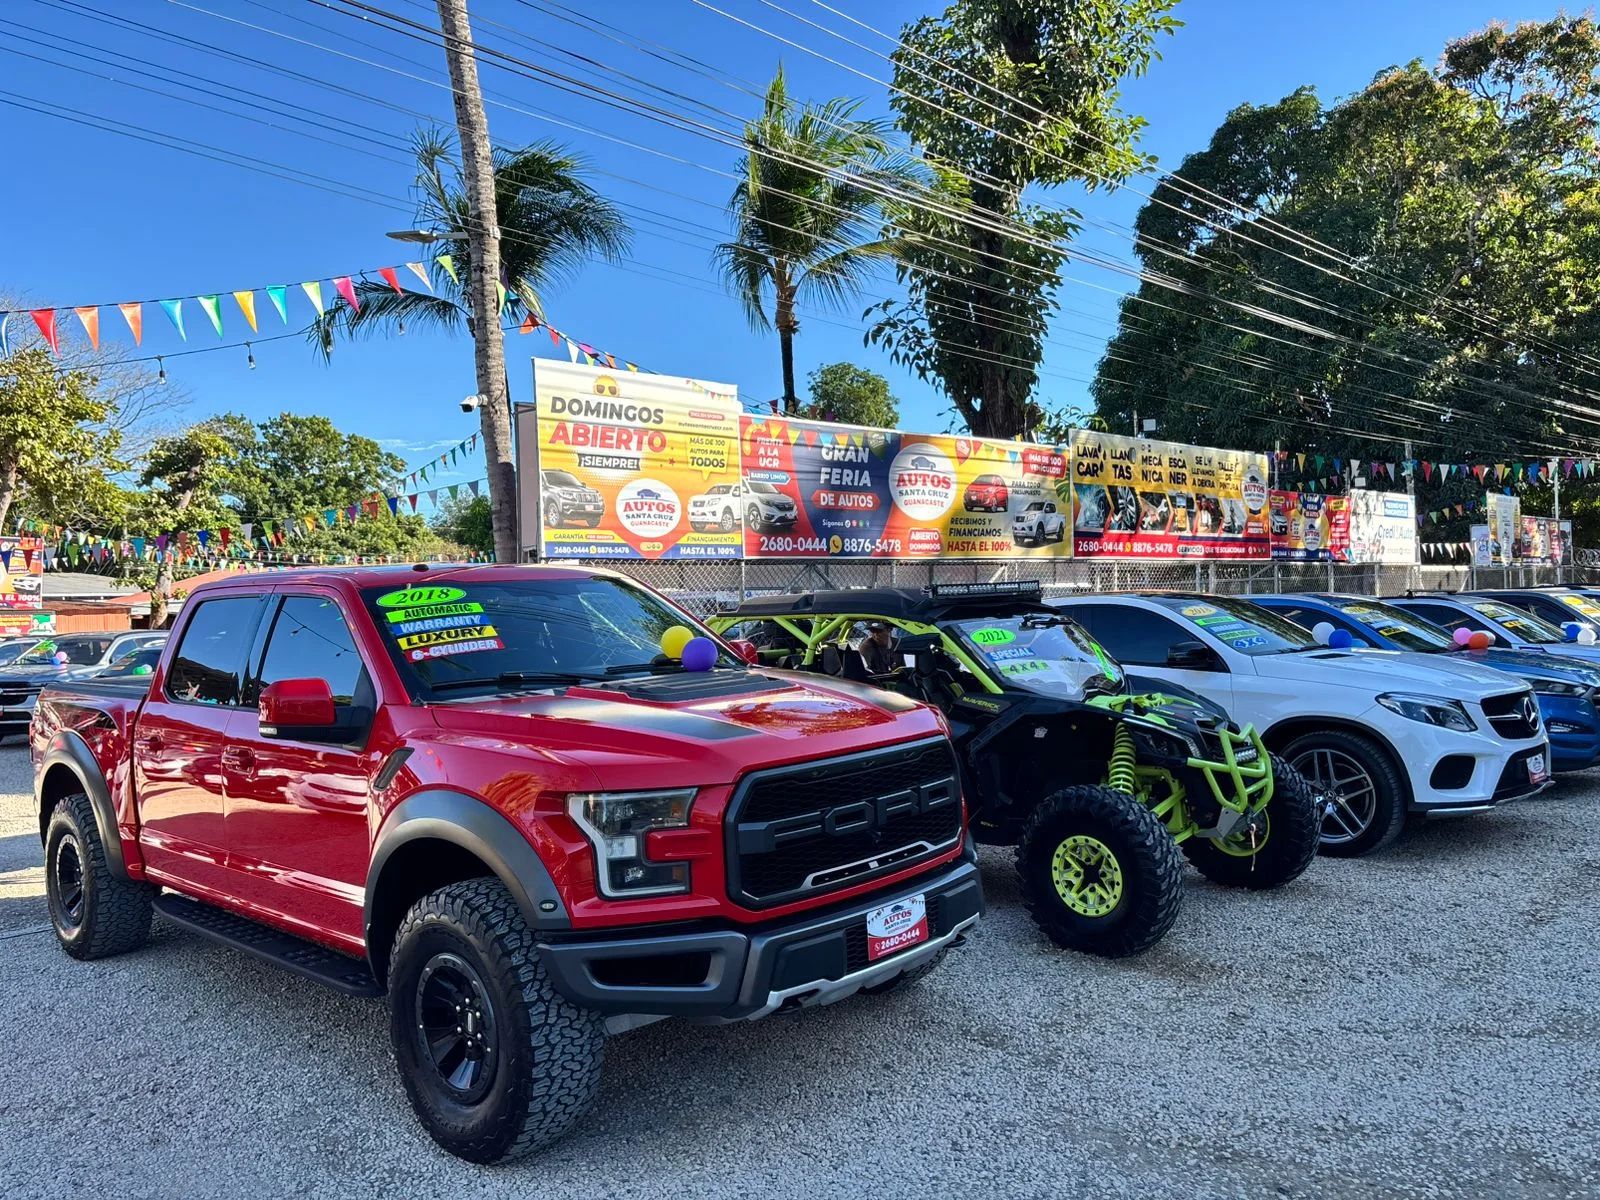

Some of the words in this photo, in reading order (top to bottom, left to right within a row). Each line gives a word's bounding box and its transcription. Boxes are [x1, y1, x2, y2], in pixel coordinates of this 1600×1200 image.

[550, 396, 664, 424] DOMINGOS
[549, 422, 667, 453] ABIERTO
[690, 437, 704, 445] MÁS
[756, 436, 784, 446] FRENTE
[758, 447, 766, 455] A
[768, 448, 779, 456] LA
[821, 445, 870, 463] GRAN
[1077, 446, 1100, 459] LAVA
[580, 454, 638, 469] ¡SIEMPRE!
[690, 456, 726, 468] TODOS
[759, 458, 780, 468] UCR
[1042, 455, 1049, 464] DE
[1050, 456, 1062, 466] 100
[1142, 454, 1162, 467] MECÁ
[1168, 456, 1187, 470] ESCA
[1196, 456, 1202, 466] SE
[751, 472, 770, 480] BARRIO
[770, 472, 786, 481] LIMÓN
[1077, 462, 1100, 478] CAR
[1112, 464, 1132, 480] TAS
[820, 467, 872, 487] FERIA
[896, 472, 952, 490] AUTOS
[1169, 471, 1187, 486] NER
[898, 489, 928, 498] SANTA
[928, 489, 949, 499] CRUZ
[1244, 484, 1265, 494] AUTOS
[623, 501, 676, 514] AUTOS
[820, 494, 835, 506] DE
[838, 494, 874, 508] AUTOS
[904, 498, 944, 508] GUANACASTE
[630, 520, 669, 528] GUANACASTE
[950, 517, 986, 526] RECIBIMOS
[988, 518, 992, 526] Y
[910, 531, 938, 540] ABIERTO
[948, 528, 1002, 537] FINANCIAMOS
[554, 546, 589, 554] 2680-0444
[680, 546, 704, 554] HASTA
[706, 547, 714, 555] EL
[760, 536, 828, 552] 2680-0444
[844, 538, 902, 552] 8876-5478
[910, 542, 940, 551] DOMINGOS
[947, 540, 976, 552] HASTA
[980, 541, 990, 551] EL
[991, 541, 1011, 551] 100%
[1078, 541, 1124, 552] 2680-0444
[1132, 542, 1173, 553] 8876-5478
[395, 588, 451, 604] 2018
[404, 604, 473, 619] AUTOMATIC
[400, 614, 481, 634] WARRANTY
[406, 627, 486, 646] LUXURY
[980, 630, 1008, 643] 2021
[412, 640, 499, 661] 6-CYLINDER
[990, 648, 1034, 660] SPECIAL
[962, 696, 1000, 710] MAVERICK
[738, 777, 956, 855] FORD
[884, 909, 912, 927] AUTOS
[880, 928, 920, 950] 2680-0444
